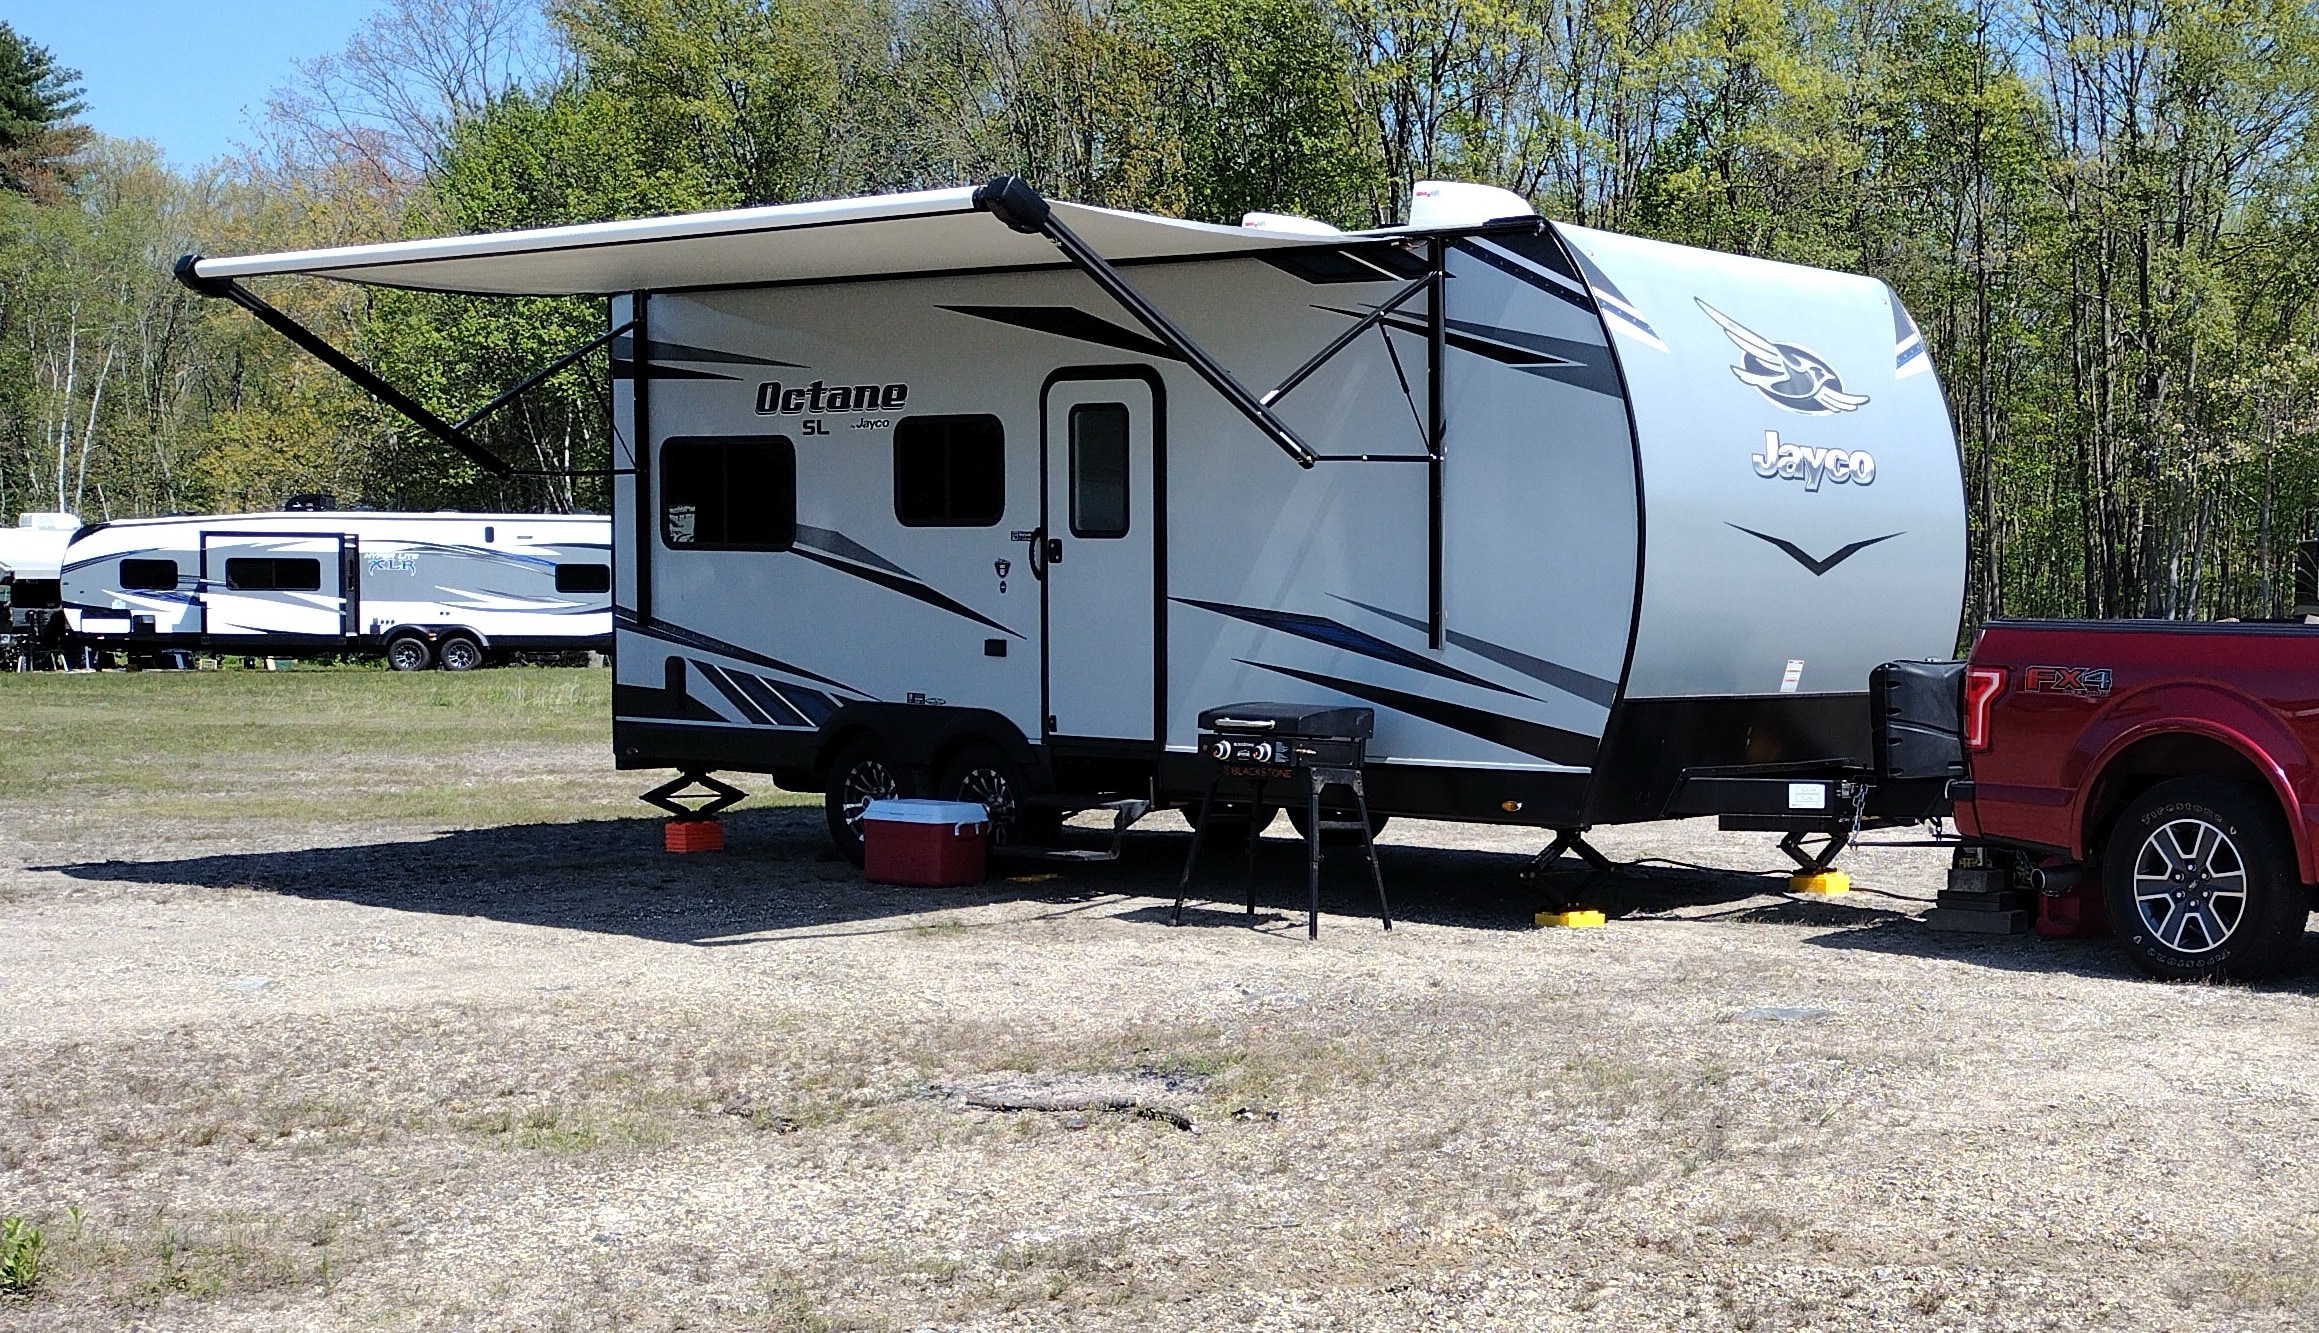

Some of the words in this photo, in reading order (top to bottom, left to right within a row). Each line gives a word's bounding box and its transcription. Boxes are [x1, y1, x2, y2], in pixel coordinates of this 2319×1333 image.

[755, 380, 909, 416] Octane
[802, 418, 830, 436] SL
[856, 417, 890, 431] Jayco
[1751, 429, 1877, 494] Jayco
[368, 559, 417, 577] XLR
[2024, 664, 2113, 693] FX4
[1231, 766, 1293, 779] BLACKSTONE
